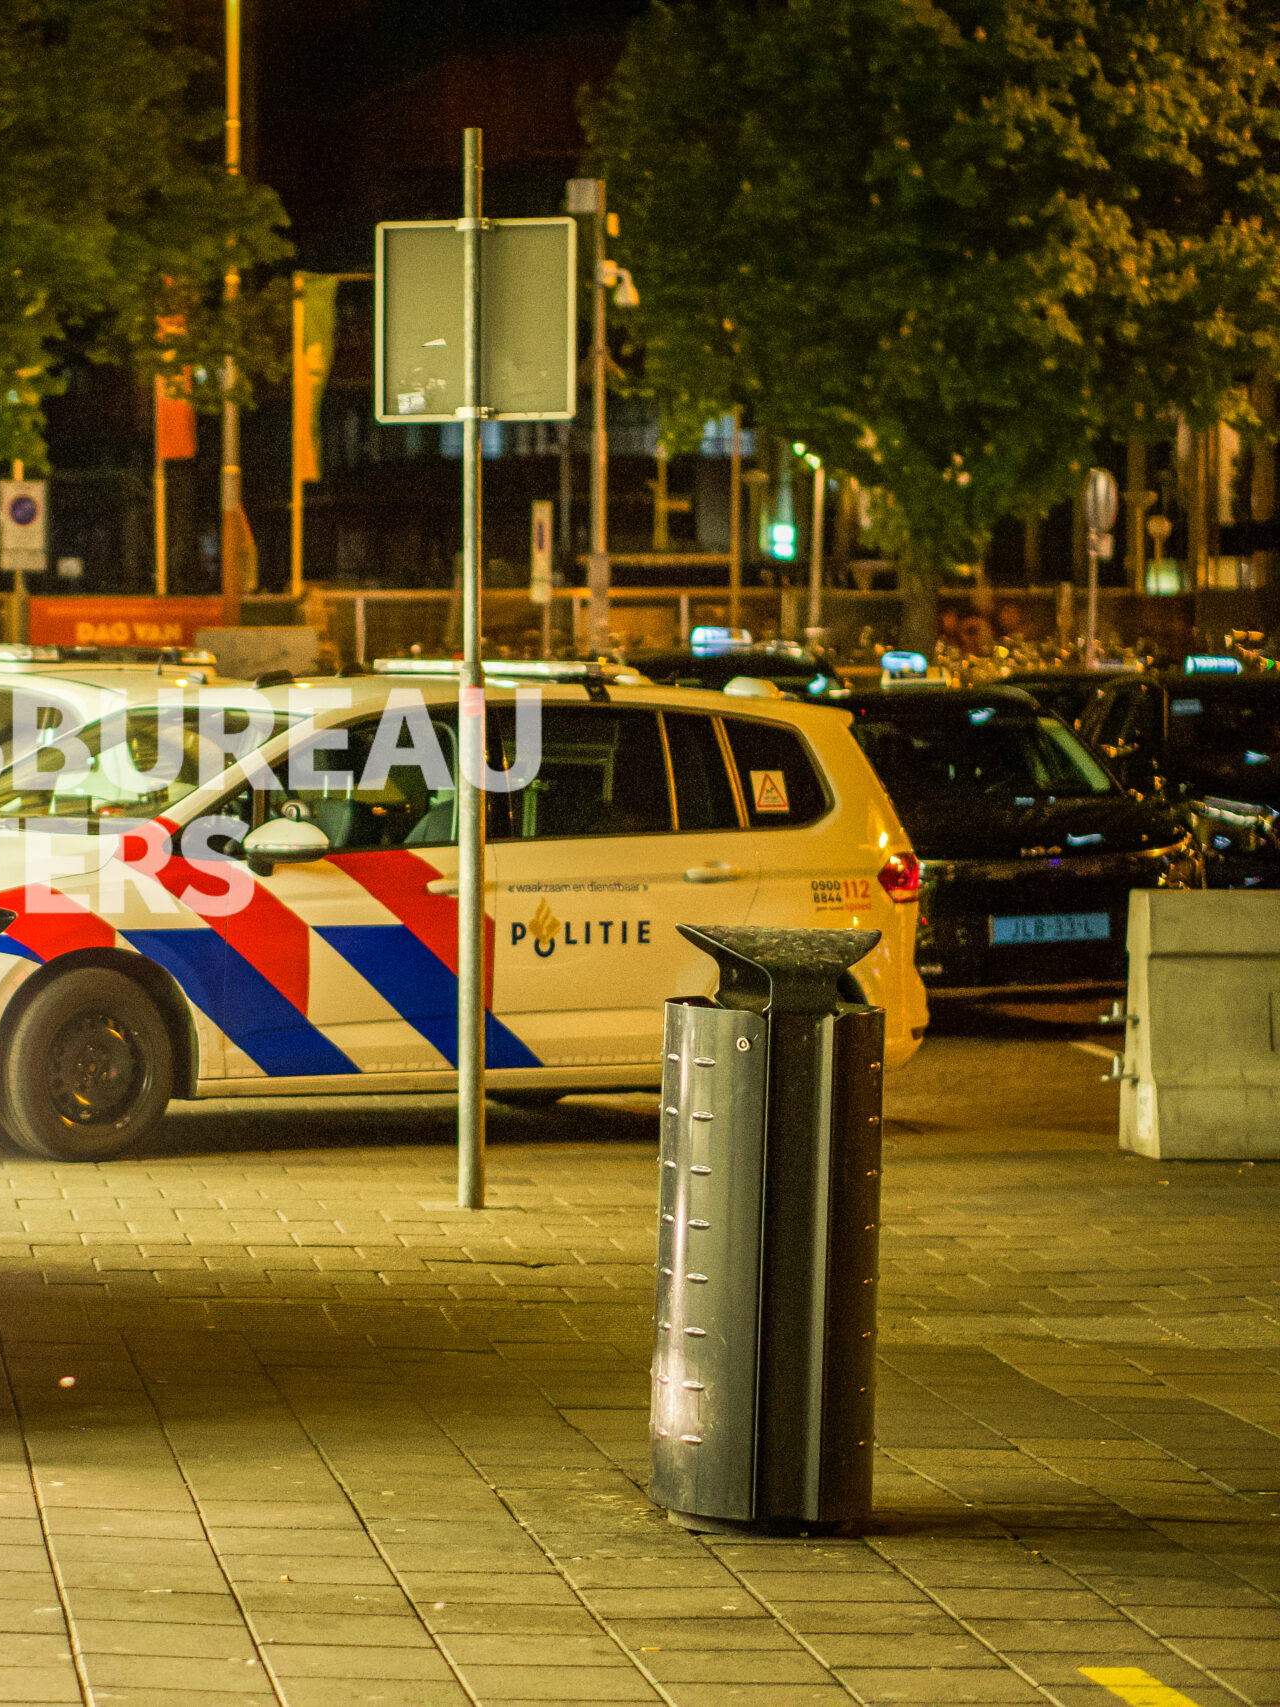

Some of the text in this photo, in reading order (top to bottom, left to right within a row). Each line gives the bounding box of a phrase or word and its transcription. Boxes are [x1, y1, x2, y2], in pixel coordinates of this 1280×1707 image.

[516, 882, 571, 893] waakzaam
[573, 883, 584, 892] en
[811, 880, 841, 891] 0900
[843, 880, 871, 899] 112
[814, 892, 842, 903] 8844
